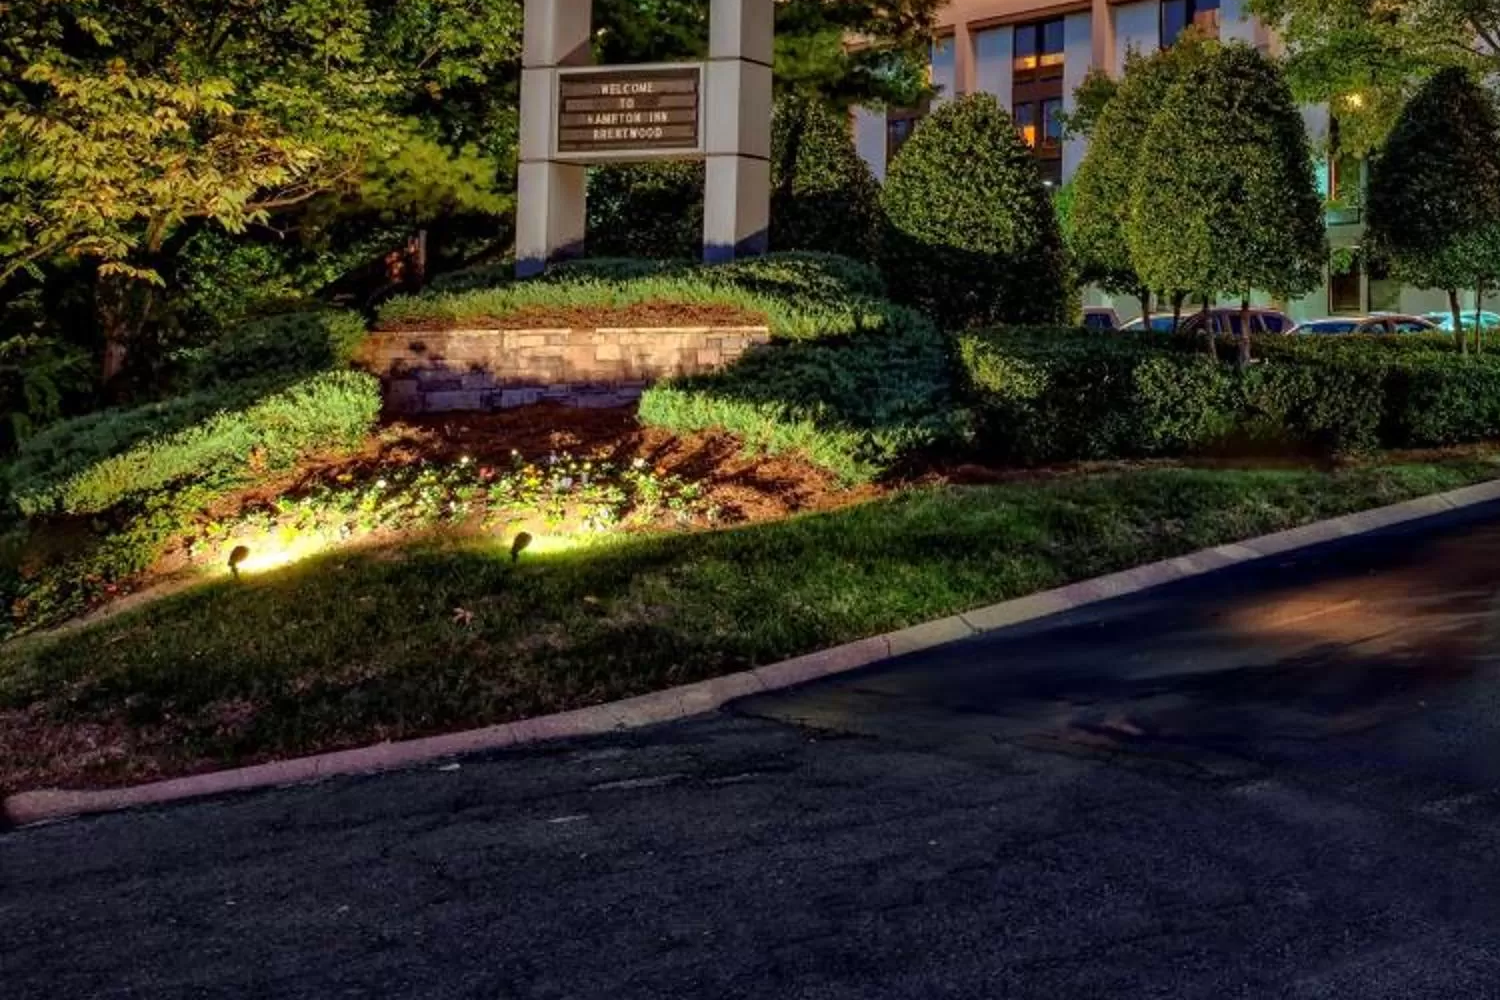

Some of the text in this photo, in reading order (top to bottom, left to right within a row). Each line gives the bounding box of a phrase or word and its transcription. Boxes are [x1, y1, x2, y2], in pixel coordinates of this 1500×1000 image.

[600, 82, 653, 95] WELCOME
[619, 97, 635, 109] TO
[587, 110, 669, 125] HAMPTON INN
